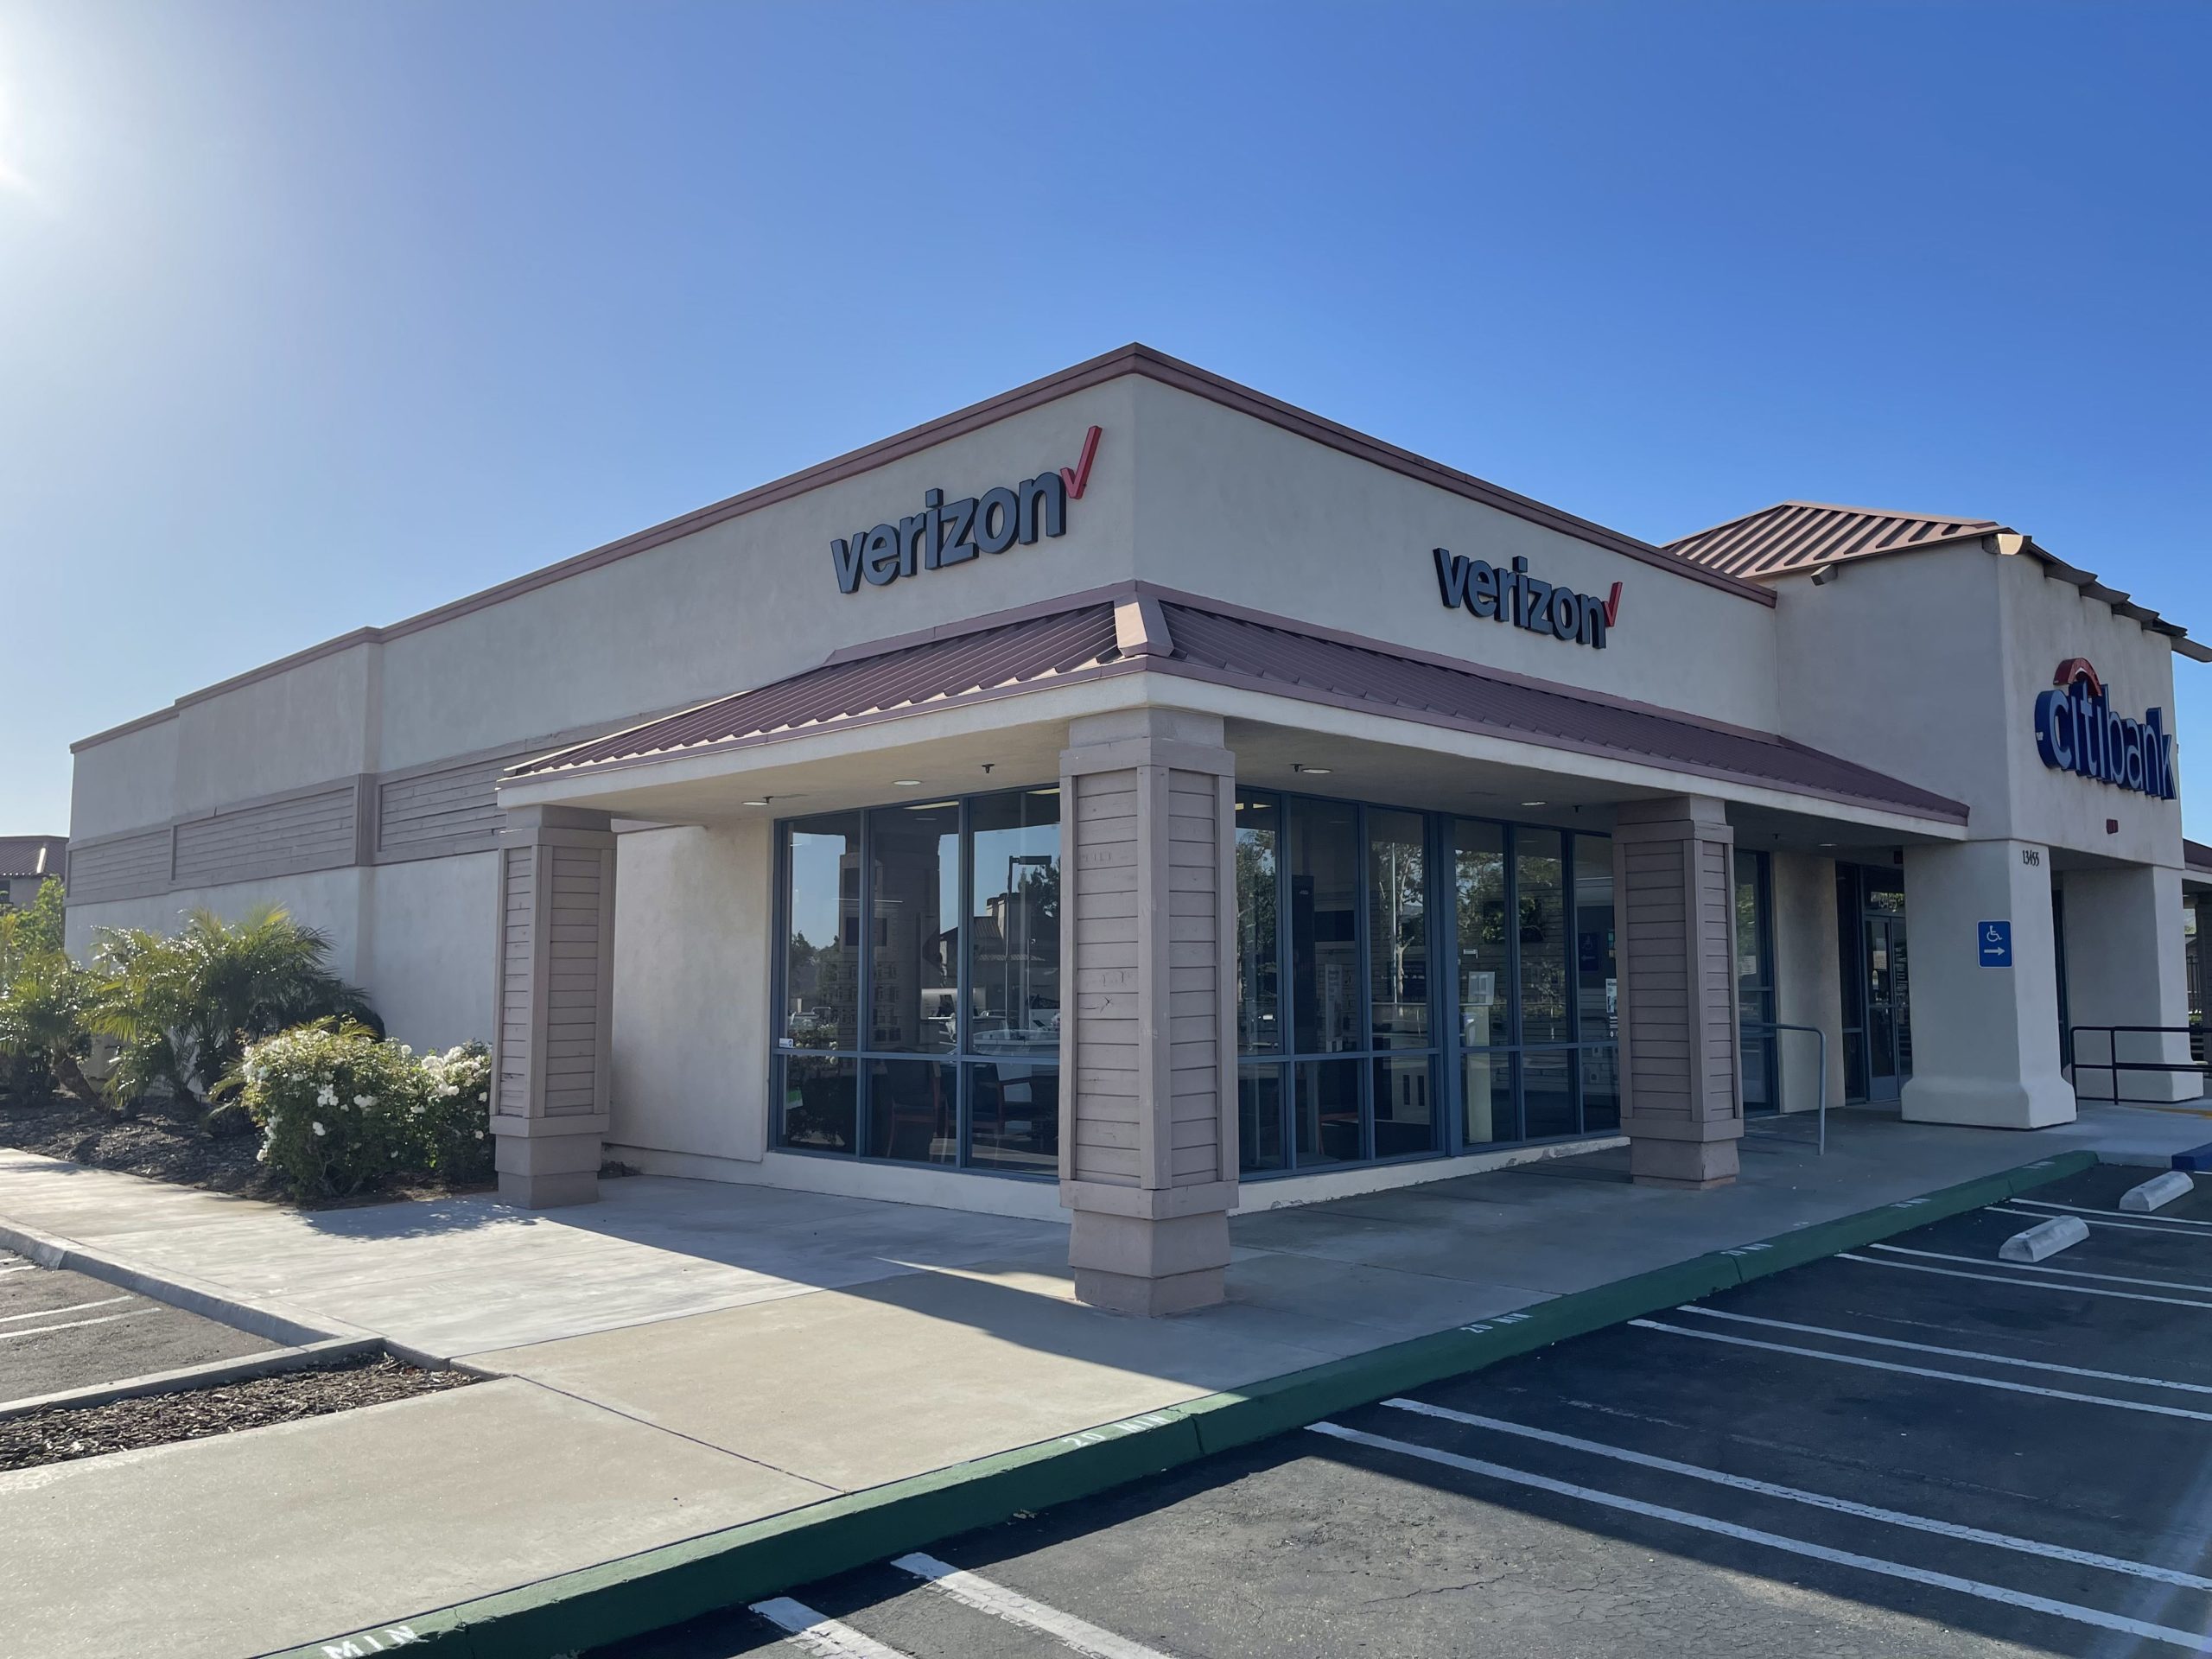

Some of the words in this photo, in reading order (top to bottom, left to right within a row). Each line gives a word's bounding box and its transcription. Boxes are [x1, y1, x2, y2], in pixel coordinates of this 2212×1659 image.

[830, 472, 1066, 594] verizon
[1433, 548, 1607, 649] verizon
[2035, 679, 2177, 800] citibank
[2022, 849, 2039, 867] 13455
[1459, 1324, 1493, 1333] 20
[1062, 1433, 1106, 1447] 20
[1114, 1414, 1173, 1433] MIN
[321, 1624, 423, 1659] MIN
